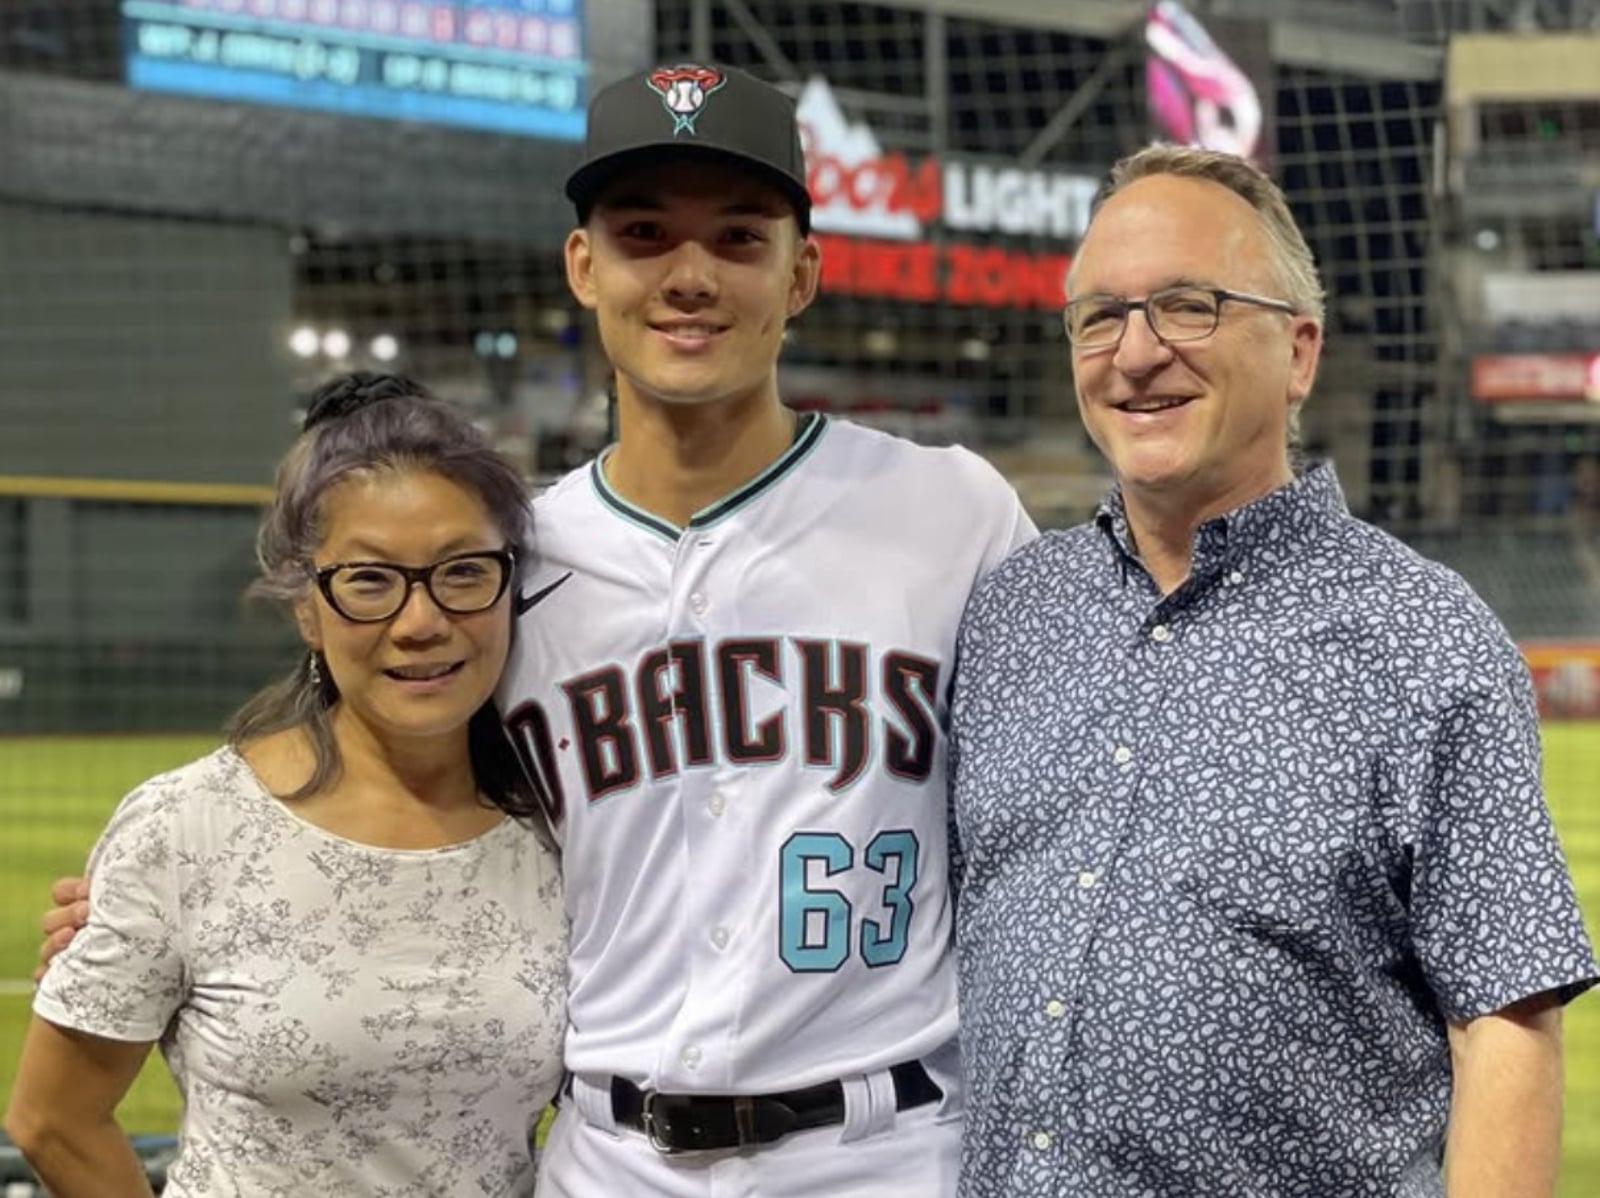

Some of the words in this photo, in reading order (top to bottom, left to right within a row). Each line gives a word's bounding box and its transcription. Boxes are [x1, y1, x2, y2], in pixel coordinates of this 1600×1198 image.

[944, 160, 1099, 239] LIGHT
[810, 234, 938, 303] RIKE
[778, 829, 920, 973] 63
